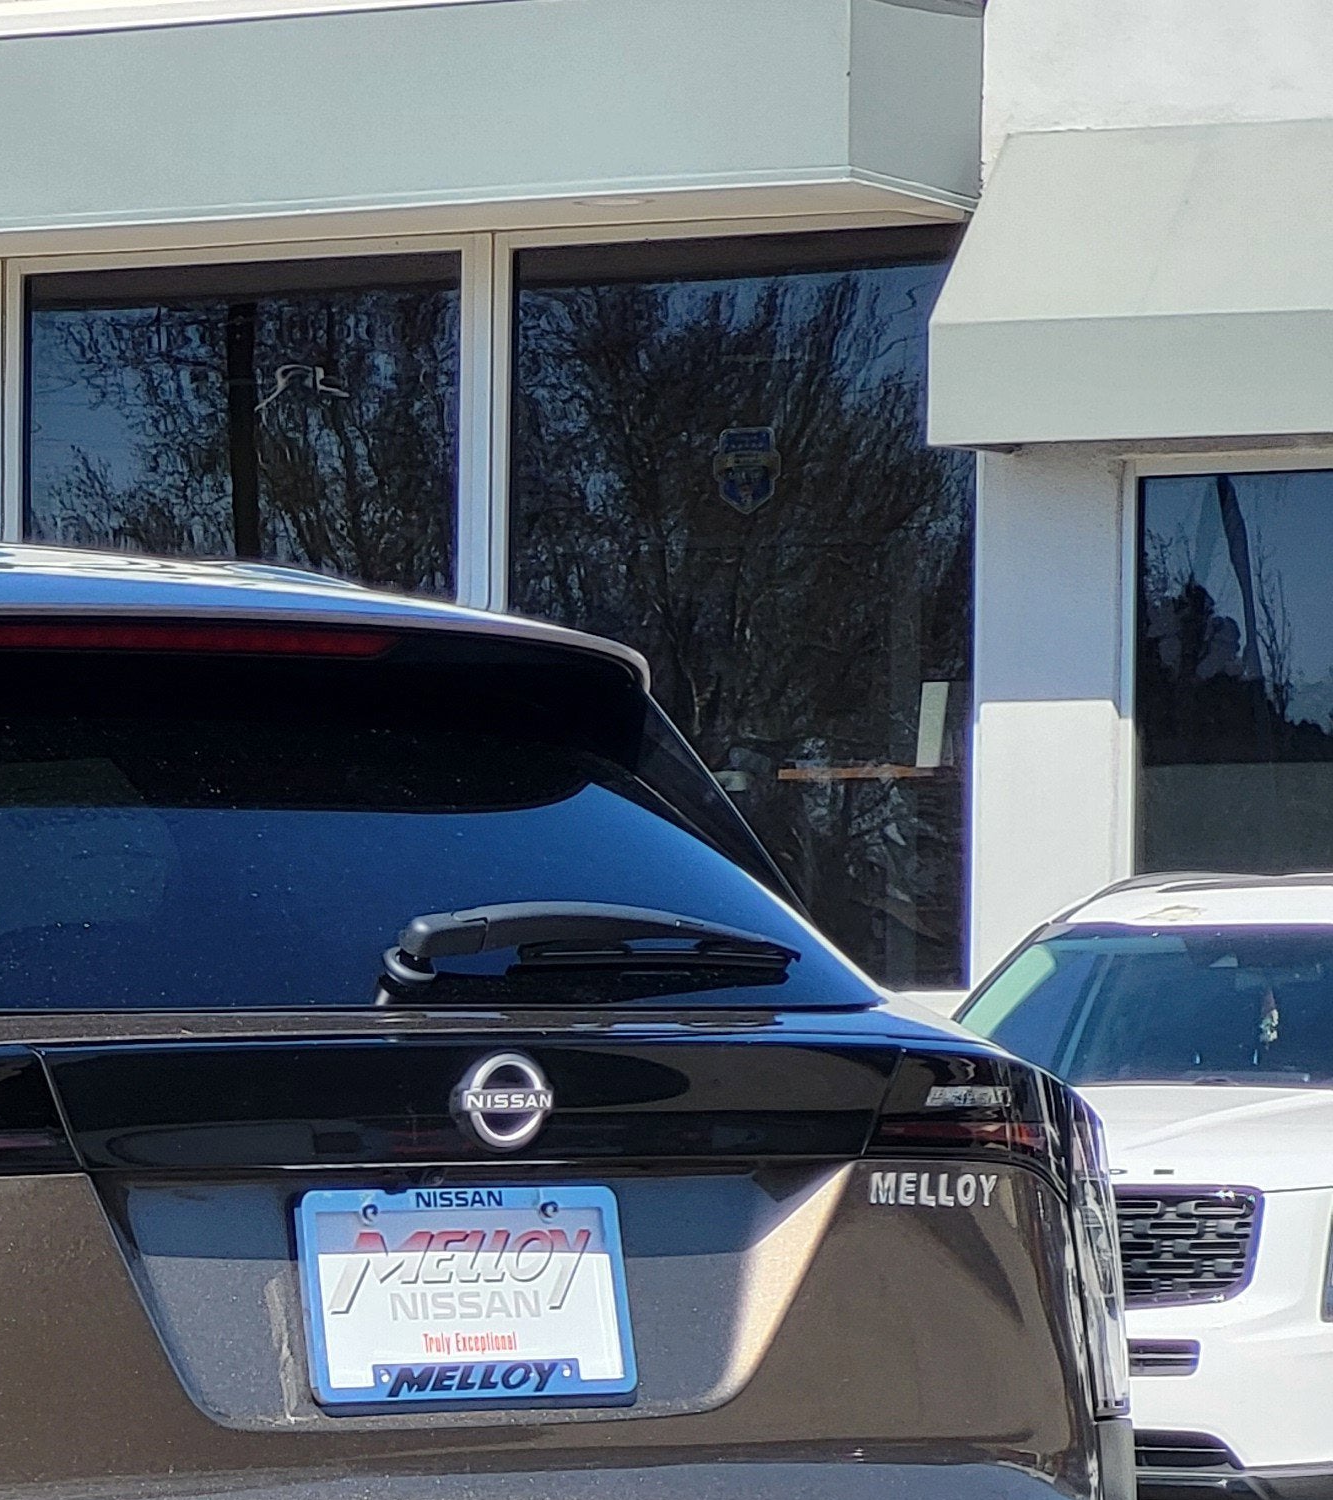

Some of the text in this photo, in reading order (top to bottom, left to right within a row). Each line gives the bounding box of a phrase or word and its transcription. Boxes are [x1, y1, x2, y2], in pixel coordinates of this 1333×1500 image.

[466, 1093, 552, 1109] NISSAN
[415, 1189, 503, 1208] NISSAN
[869, 1172, 998, 1207] MELLOY
[327, 1228, 590, 1315] MELLOY
[389, 1289, 542, 1321] NISSAN
[422, 1331, 518, 1355] Truly Exceptional
[388, 1362, 560, 1398] MELLOY
